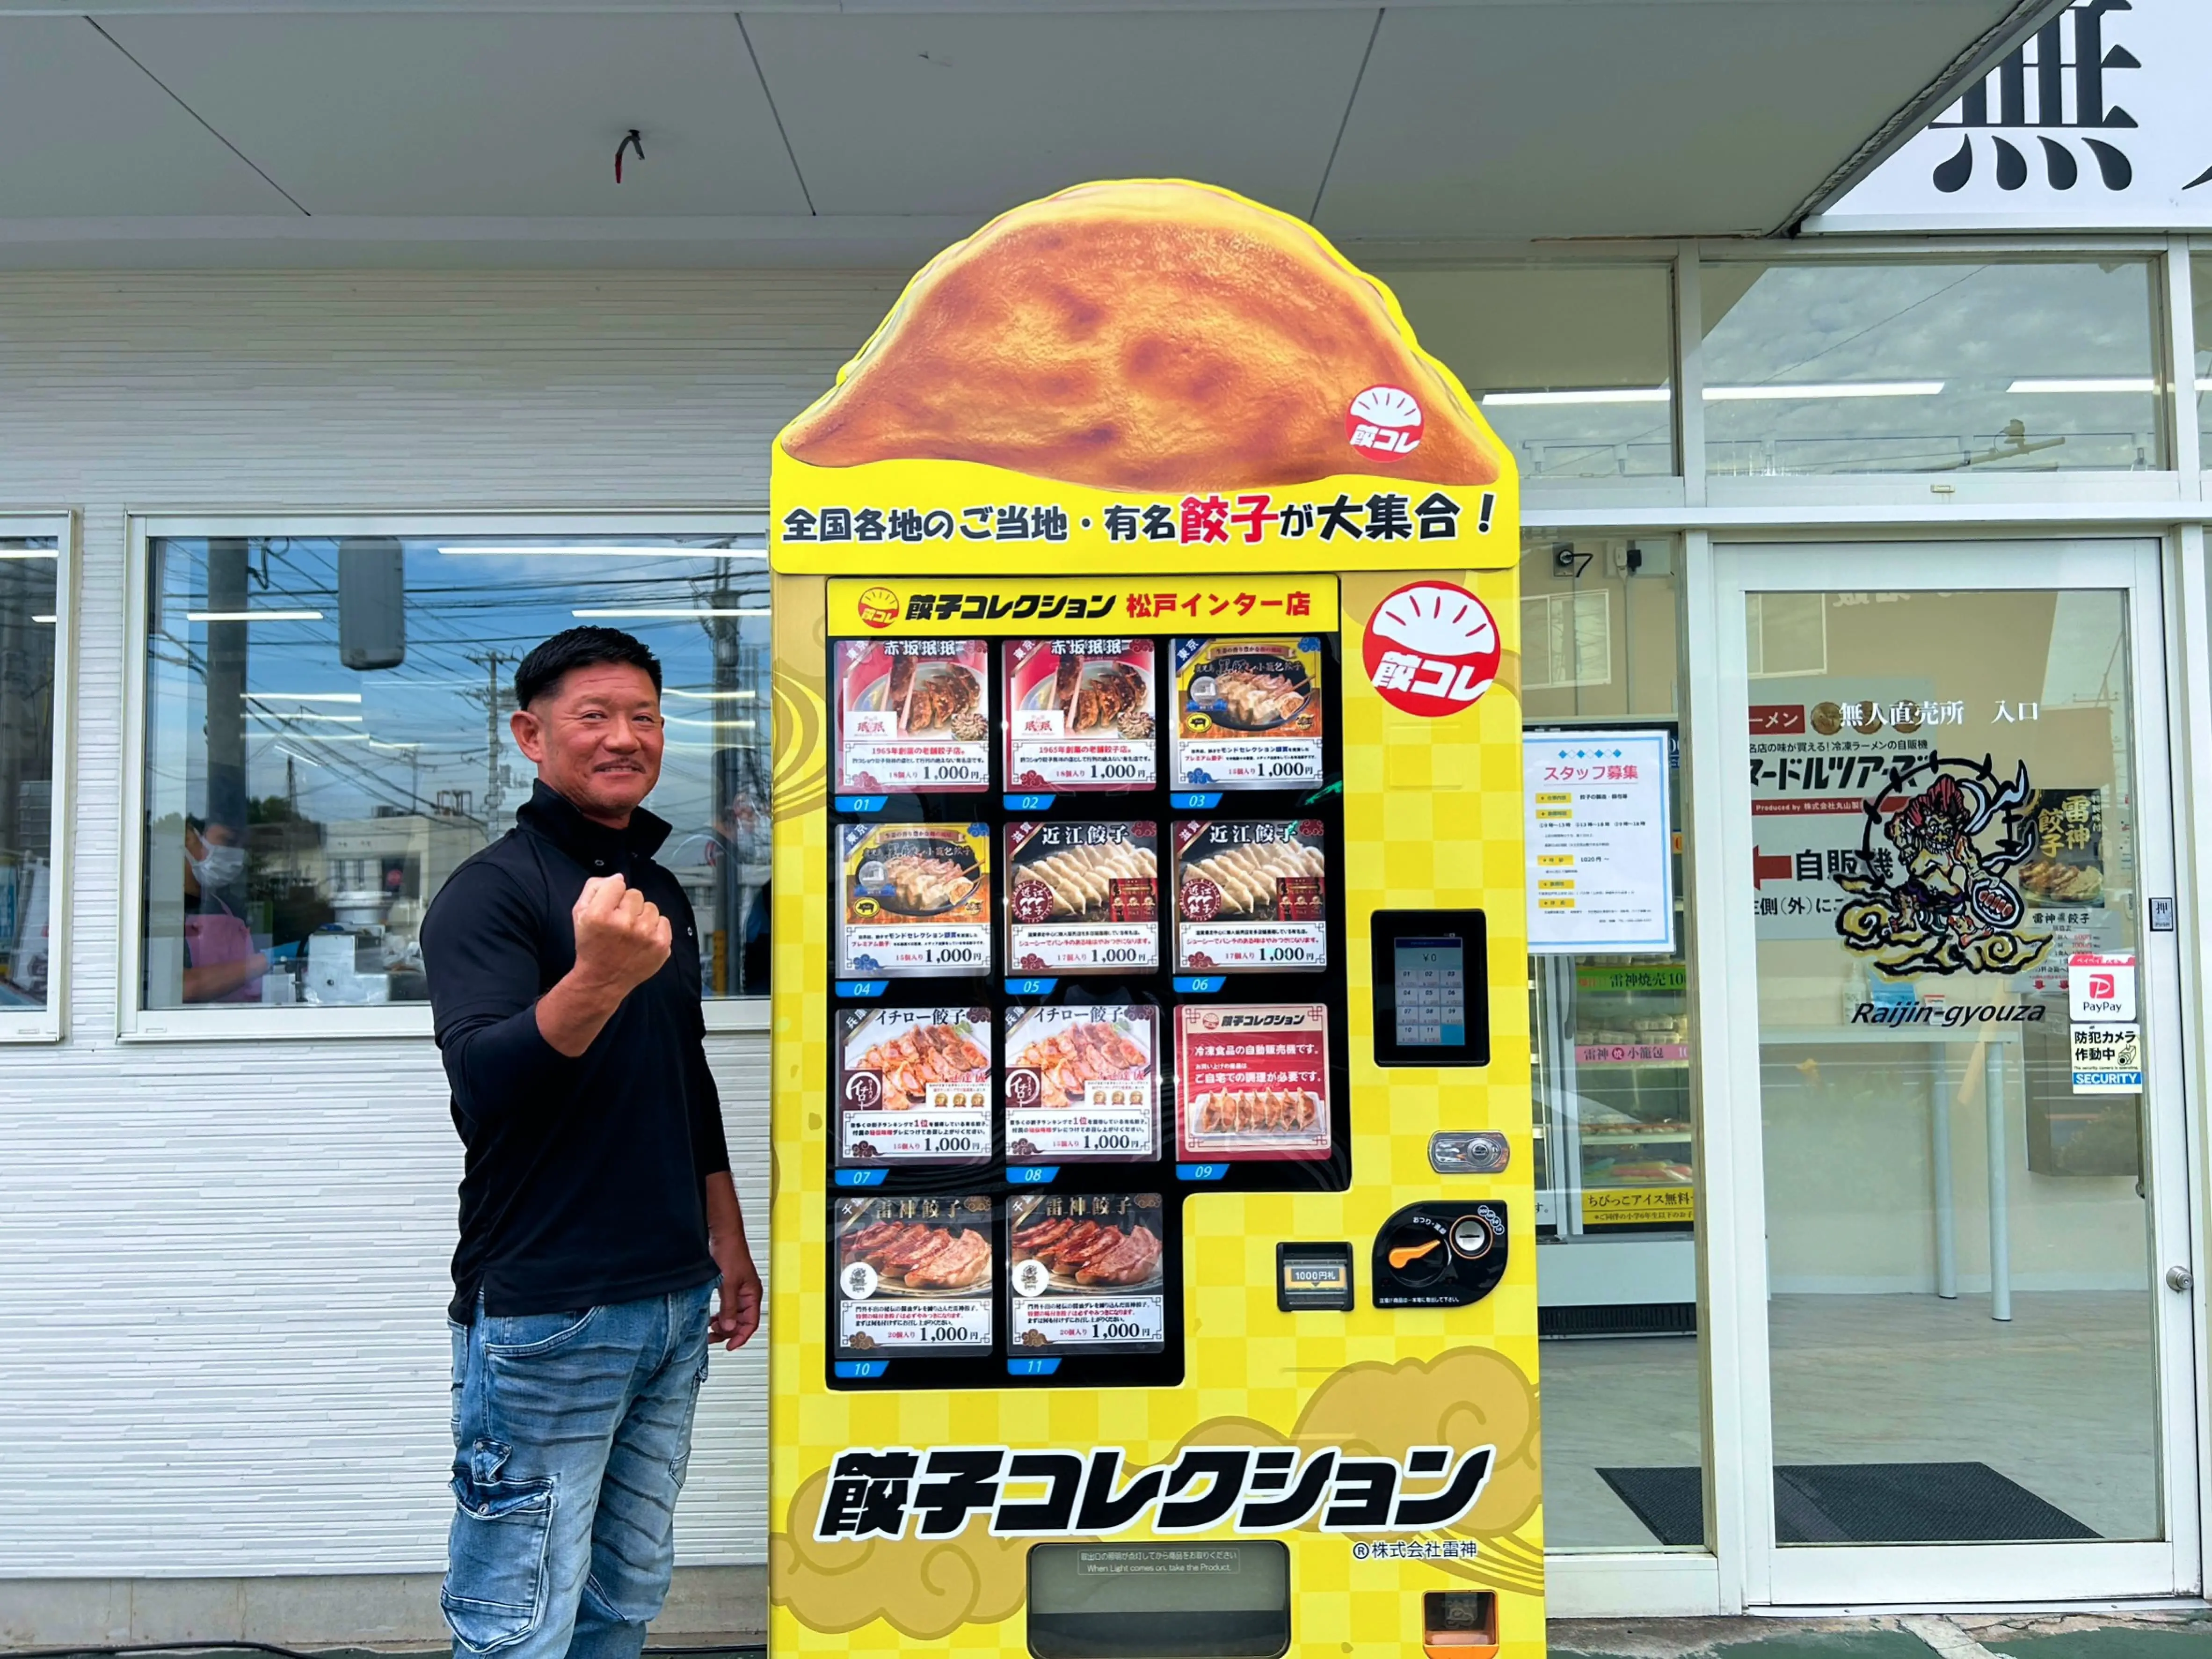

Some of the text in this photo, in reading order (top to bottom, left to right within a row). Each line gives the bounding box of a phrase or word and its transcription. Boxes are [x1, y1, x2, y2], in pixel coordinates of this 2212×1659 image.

[782, 493, 1496, 544] 全国各地のご当地・有名餃子が大集合！
[905, 592, 1310, 620] 餃子コレクション 松戸インター店
[1178, 639, 1199, 661] 東京
[1839, 700, 2038, 727] 無人直売所 入口
[924, 766, 979, 780] 1,000円
[1091, 765, 1146, 779] 1,000円
[1258, 762, 1313, 778] 1,000円
[1544, 765, 1638, 781] スタッフ募集
[854, 799, 870, 811] 01
[1022, 797, 1039, 809] 02
[1189, 795, 1206, 807] 03
[1804, 800, 1863, 811] 株式会社丸山製
[1042, 825, 1130, 845] 近江餃子
[1209, 824, 1298, 844] 近江餃子
[926, 948, 982, 963] 1,000円
[1091, 948, 1146, 963] 1,000円
[1259, 946, 1314, 961] 1,000円
[854, 983, 871, 995] 04
[1023, 981, 1040, 992] 05
[1192, 979, 1208, 990] 06
[1034, 1006, 1124, 1022] イチロー餃子
[1851, 1001, 2046, 1028] Raijin-gyouza
[2083, 1001, 2122, 1013] PayPay
[876, 1009, 966, 1025] イチロー餃子
[2074, 1031, 2136, 1045] 防犯カメラ
[2075, 1047, 2115, 1061] 作動中
[2076, 1073, 2138, 1084] SECURITY
[924, 1137, 980, 1152] 1,000円
[1084, 1134, 1139, 1150] 1,000円
[854, 1171, 871, 1184] 07
[1025, 1169, 1042, 1181] 08
[1195, 1165, 1212, 1178] 09
[1046, 1196, 1132, 1216] 雷神餃子
[1588, 1192, 1694, 1207] ちびっこアイス無料
[1295, 1270, 1336, 1281] 1000円札
[920, 1326, 978, 1343] 1,000円
[1092, 1324, 1150, 1339] 1,000円
[855, 1363, 870, 1375] 10
[1028, 1360, 1042, 1372] 11
[819, 1448, 1493, 1536] 餃子コレクション
